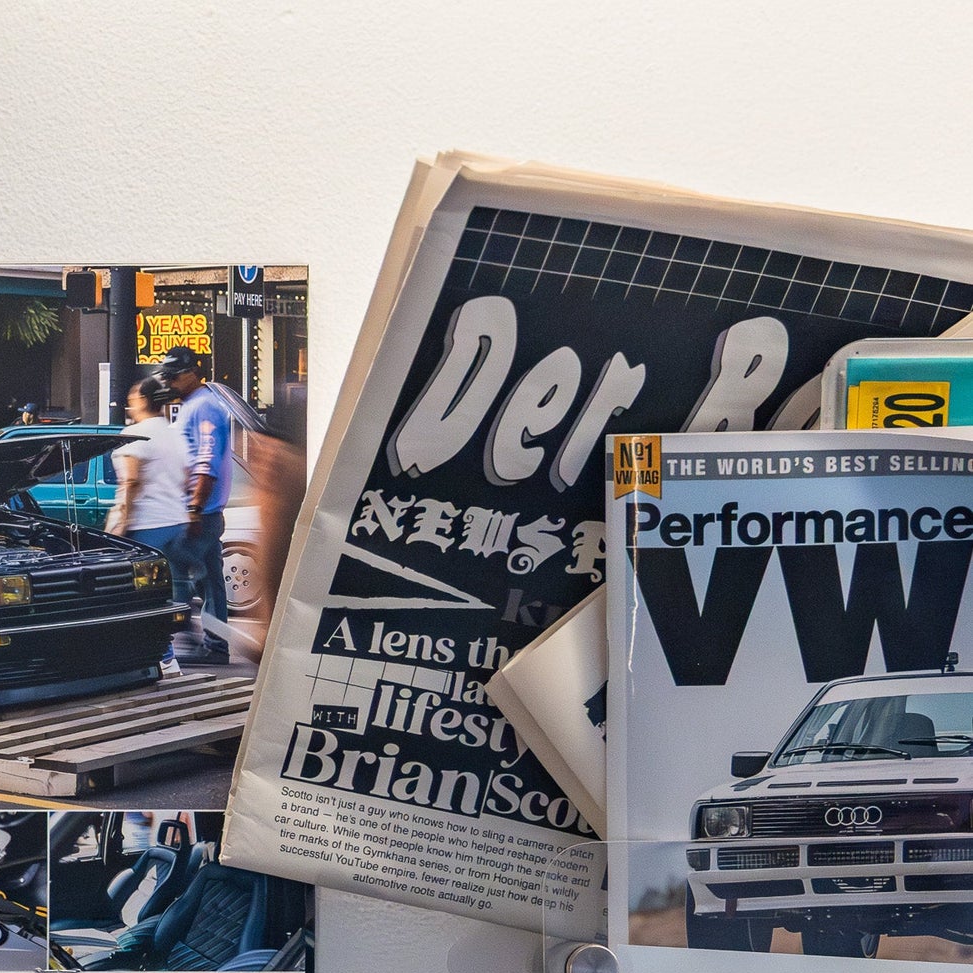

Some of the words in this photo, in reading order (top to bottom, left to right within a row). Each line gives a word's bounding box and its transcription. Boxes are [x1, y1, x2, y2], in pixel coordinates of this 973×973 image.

[146, 314, 208, 335] YEARS
[234, 292, 246, 306] PAY
[246, 293, 263, 307] HERE
[149, 334, 211, 354] BUYER
[387, 295, 646, 492] Der
[615, 470, 632, 485] VW
[633, 470, 659, 485] MAG
[667, 458, 707, 476] THE
[717, 456, 814, 476] WORLD'S
[825, 455, 879, 473] BEST
[626, 501, 973, 547] Performance
[626, 541, 973, 687] VW
[323, 616, 358, 651] A
[368, 621, 456, 662] lens
[468, 636, 523, 670] th
[451, 671, 496, 706] la
[312, 709, 357, 725] WITH
[283, 723, 480, 816] Brian
[280, 785, 313, 801] Scotto
[314, 792, 337, 806] isn't
[336, 797, 356, 810] just
[357, 803, 365, 812] a
[366, 806, 387, 818] guy
[388, 810, 410, 821] who
[411, 813, 444, 829] knows
[445, 820, 468, 833] how
[469, 826, 479, 836] to
[481, 829, 505, 844] sling
[506, 835, 514, 843] a
[516, 837, 554, 851] camera
[569, 847, 594, 859] pitch
[280, 801, 288, 810] a
[289, 801, 320, 816] brand
[335, 811, 356, 824] he's
[358, 817, 378, 829] one
[379, 821, 391, 831] of
[392, 823, 409, 835] the
[410, 828, 445, 843] people
[447, 836, 468, 848] who
[470, 839, 505, 855] helped
[506, 849, 547, 865] reshape
[273, 814, 291, 824] car
[292, 818, 329, 832] culture.
[332, 824, 360, 839] While
[362, 832, 388, 845] most
[388, 838, 424, 852] people
[425, 843, 453, 858] know
[454, 849, 473, 863] him
[475, 855, 514, 872] through
[516, 863, 532, 875] the
[570, 877, 590, 887] and
[279, 827, 296, 840] tire
[297, 833, 329, 847] marks
[330, 839, 342, 849] of
[343, 841, 360, 853] the
[361, 845, 417, 865] Gymkhana
[454, 866, 466, 875] or
[467, 867, 490, 880] from
[551, 886, 579, 901] wildly
[279, 843, 334, 861] successful
[334, 852, 379, 871] YouTube
[420, 870, 450, 886] fewer
[450, 879, 485, 893] realize
[485, 887, 506, 897] just
[506, 889, 529, 902] how
[530, 895, 557, 910] deep
[558, 900, 574, 911] his
[352, 873, 408, 891] automotive
[409, 885, 435, 897] roots
[437, 890, 476, 907] actually
[476, 899, 493, 909] go.
